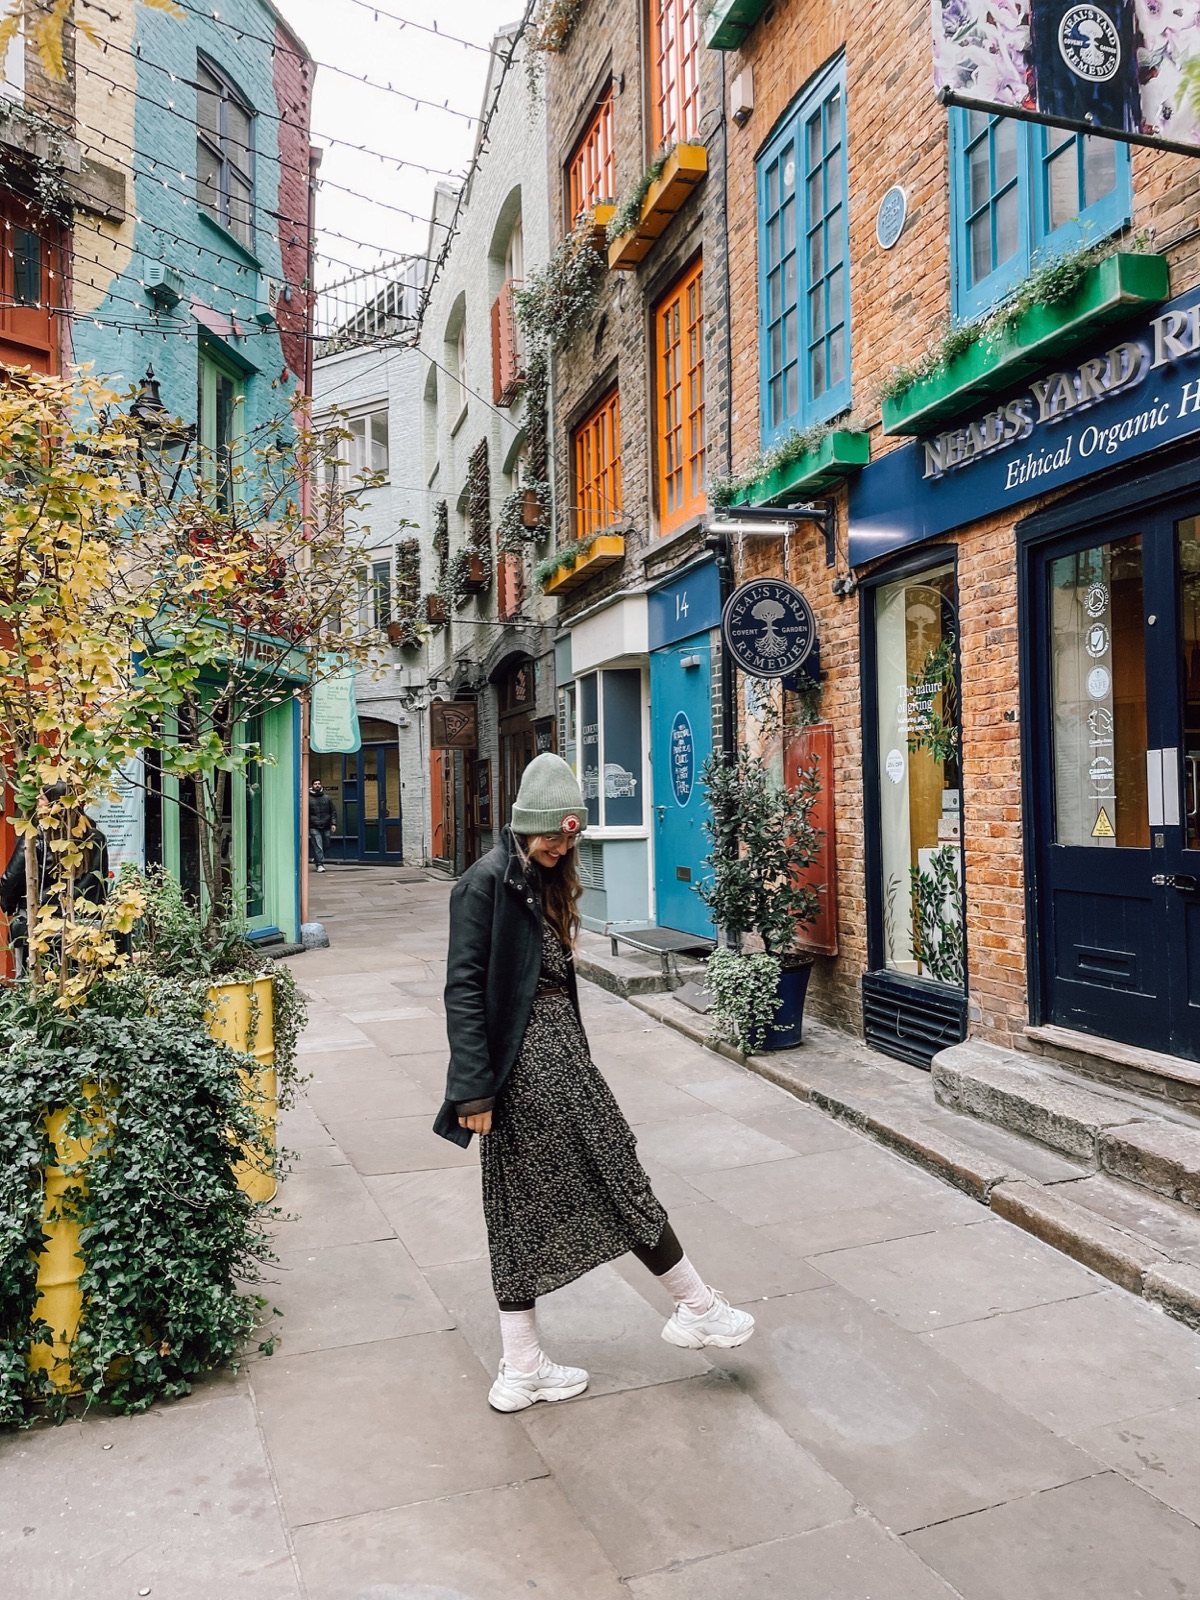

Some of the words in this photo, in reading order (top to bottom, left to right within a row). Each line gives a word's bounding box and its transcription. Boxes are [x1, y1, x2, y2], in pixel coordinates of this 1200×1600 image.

[1063, 10, 1094, 37] NEAL'S
[1096, 13, 1116, 46] YARD
[1066, 47, 1115, 76] REMEDIES
[922, 397, 1027, 480] NEAL'S
[1029, 342, 1144, 425] YARD
[1004, 435, 1072, 491] Ethical
[1078, 397, 1170, 457] Organic
[675, 591, 689, 621] 14
[732, 587, 770, 626] NEAL'S
[774, 588, 806, 622] YARD
[732, 628, 758, 637] COVENT
[781, 625, 808, 633] GARDEN
[736, 636, 806, 669] REMEDIES
[896, 685, 914, 698] The
[915, 682, 943, 696] nature
[1089, 680, 1107, 690] SAFE
[897, 700, 907, 714] of
[907, 699, 933, 716] giving
